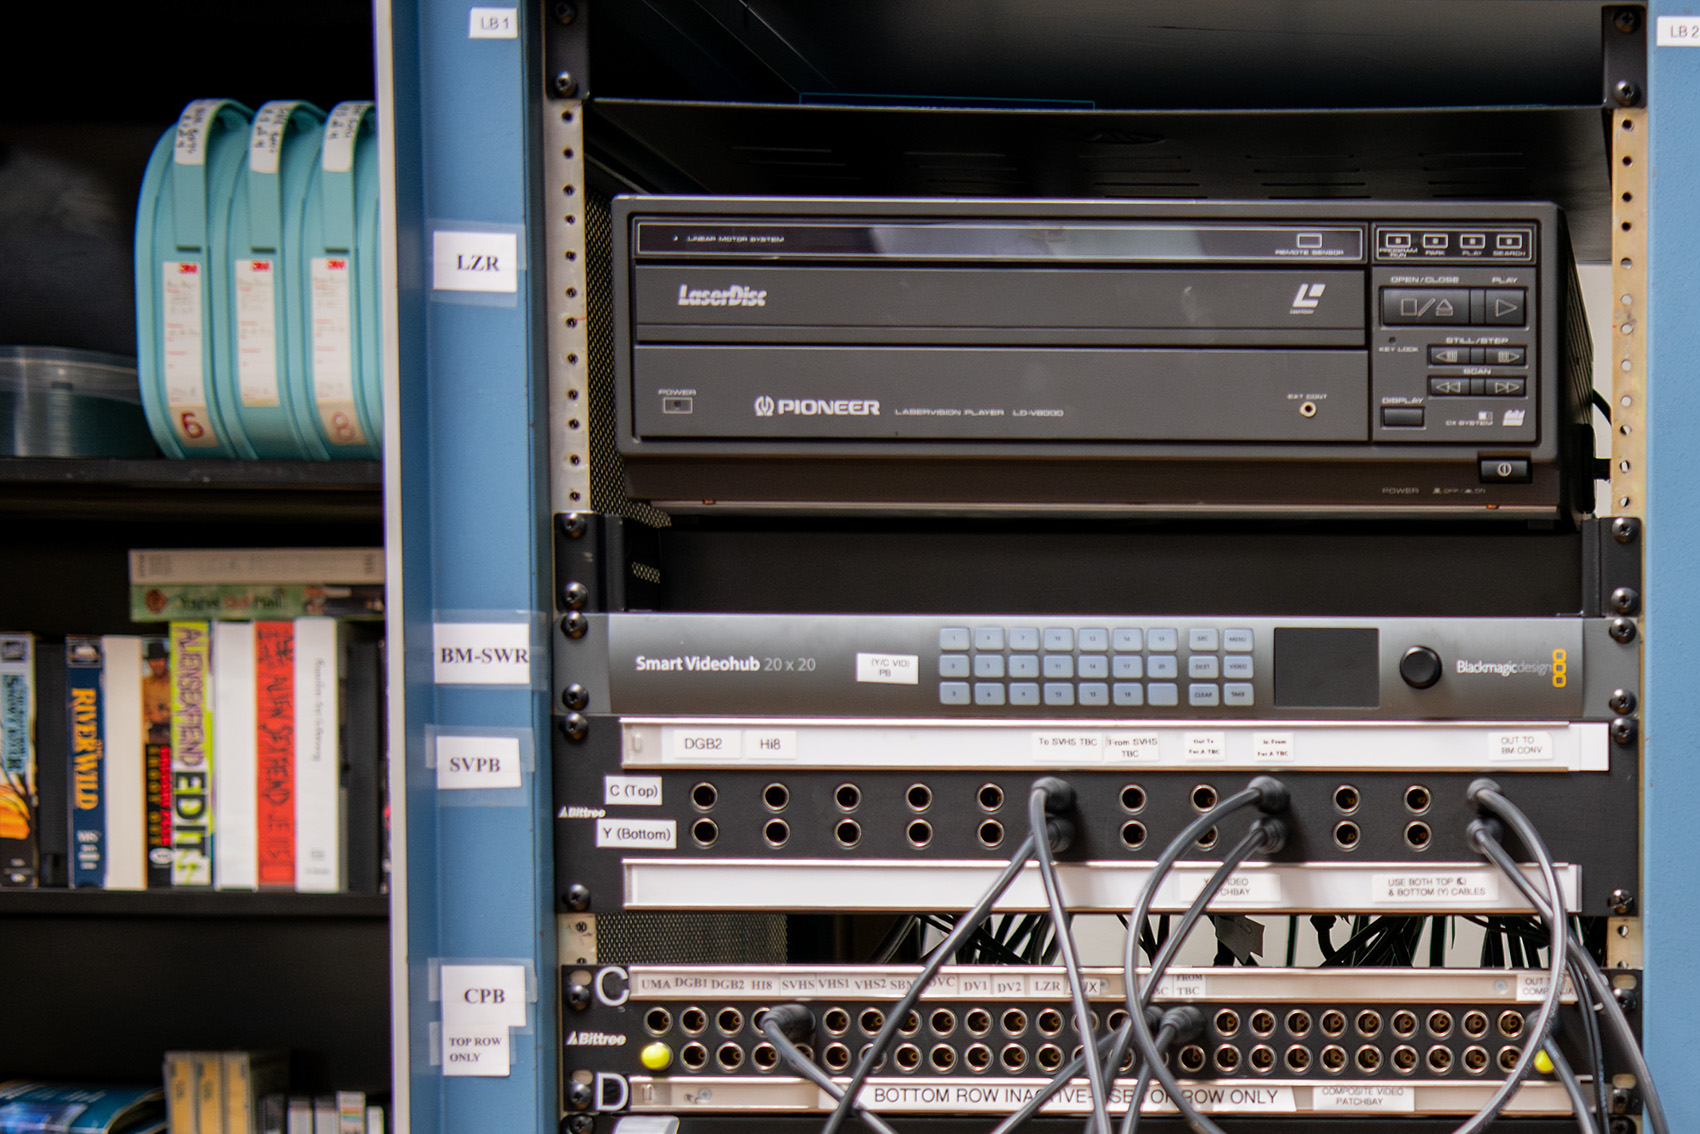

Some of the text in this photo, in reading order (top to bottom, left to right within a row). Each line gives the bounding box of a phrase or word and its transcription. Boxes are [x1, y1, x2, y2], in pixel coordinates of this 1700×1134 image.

[481, 17, 499, 30] LB
[1670, 26, 1699, 37] LB 2
[456, 254, 500, 271] LZR
[678, 285, 767, 306] LaserDisc
[778, 400, 880, 415] PIONEER
[440, 647, 529, 664] BM-SWR
[636, 655, 816, 671] Smart Videohub 20 x 20
[684, 738, 722, 749] DGB2
[760, 738, 781, 749] Hi8
[1052, 738, 1077, 746] SVHS
[1080, 738, 1097, 746] TBC
[449, 757, 502, 774] SVPB
[610, 785, 658, 797] C (Top)
[603, 828, 670, 841] Y (Bottom)
[1389, 888, 1395, 896] &
[1398, 887, 1433, 896] BOTTOM
[1451, 887, 1485, 896] CABLES
[595, 967, 630, 1006] C
[642, 980, 671, 990] UMA
[675, 978, 708, 988] DGB1
[712, 980, 745, 990] DGB2
[752, 980, 772, 990] HI8
[782, 980, 815, 990] SVHS
[819, 979, 849, 989] VHS1
[855, 980, 886, 991] VHS2
[964, 980, 987, 991] DV1
[464, 989, 505, 1004] CPB
[449, 1037, 502, 1047] TOP ROW
[577, 1033, 626, 1045] Bittree
[450, 1053, 480, 1063] ONLY
[595, 1072, 629, 1111] D
[875, 1089, 1000, 1103] BOTTOM ROW
[1231, 1090, 1278, 1104] ONLY
[1322, 1087, 1403, 1096] COMPOSITE VIDEO
[1337, 1097, 1383, 1106] PATCHBAY
